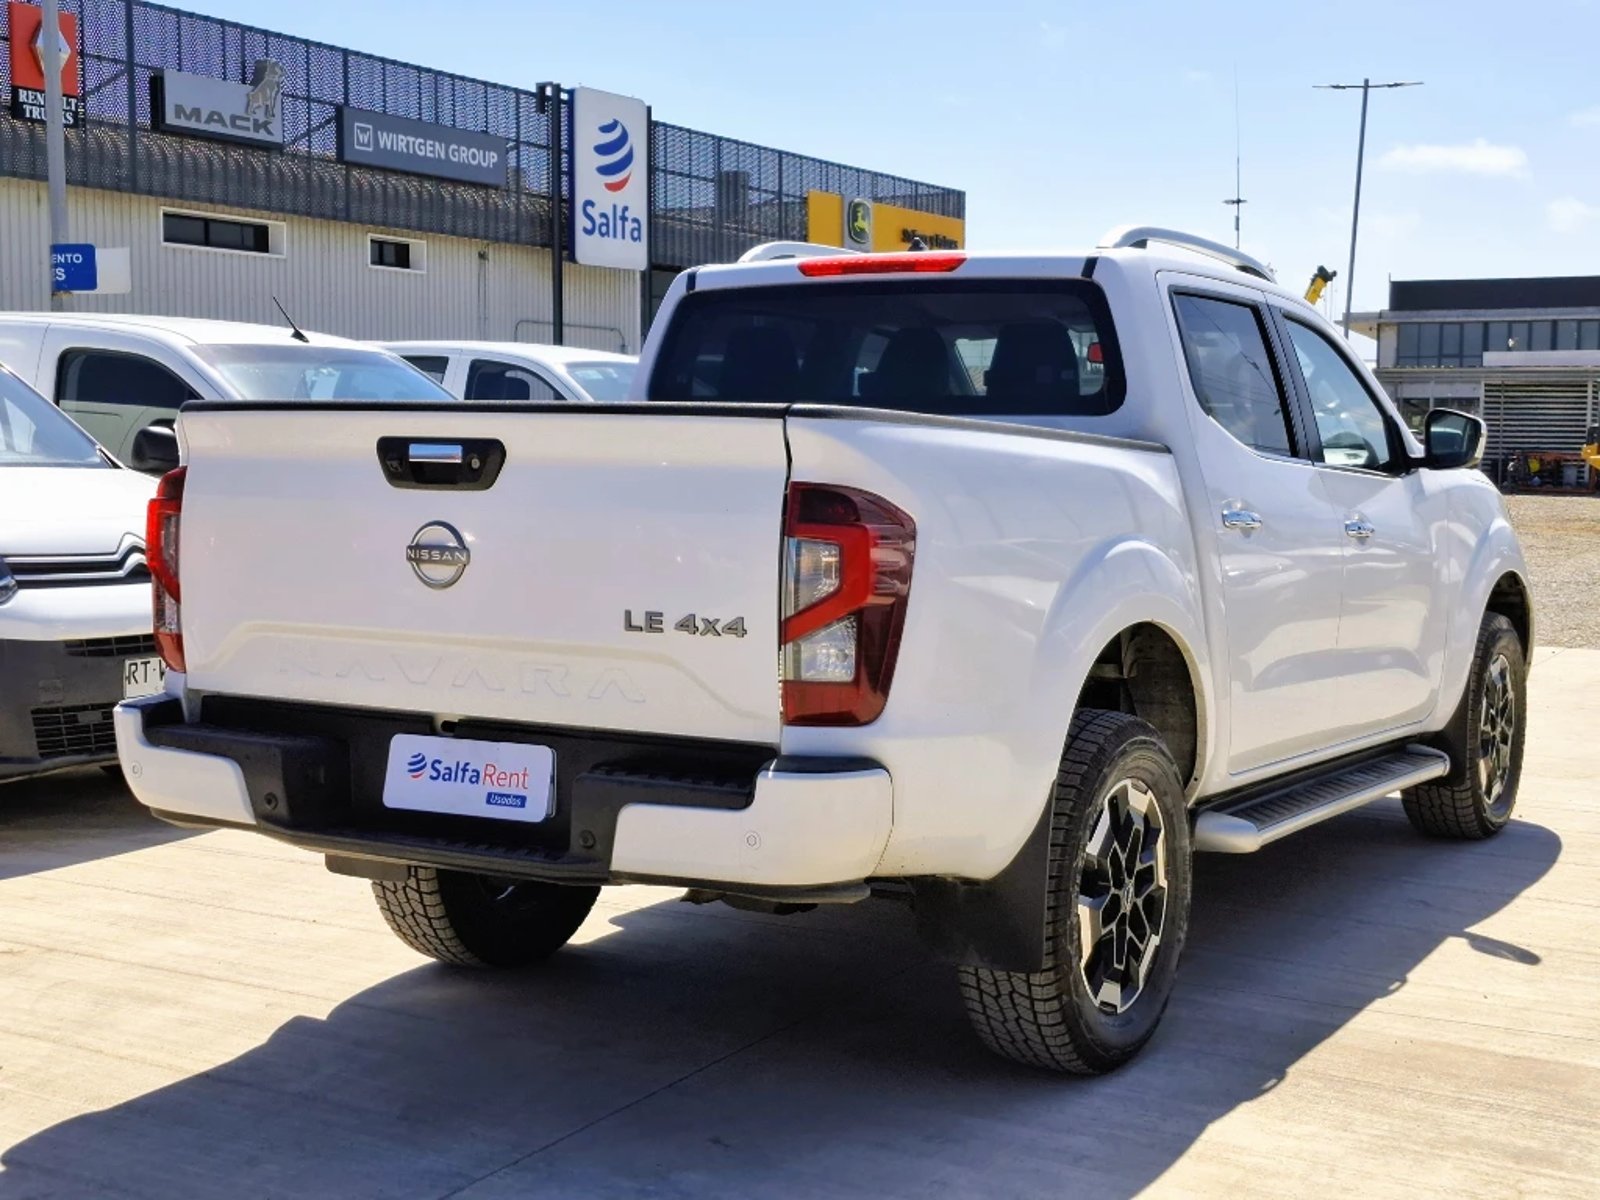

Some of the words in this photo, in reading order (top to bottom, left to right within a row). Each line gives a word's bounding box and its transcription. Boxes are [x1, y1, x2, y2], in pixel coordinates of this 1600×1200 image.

[18, 88, 77, 111] RENLT
[23, 104, 74, 125] TRUS
[174, 103, 275, 137] MACK
[377, 130, 447, 160] WIRTGEN
[448, 145, 498, 169] GROUP
[582, 199, 642, 243] Salfa
[407, 548, 467, 562] NISSAN
[624, 608, 664, 634] LE
[674, 613, 748, 638] 4x4
